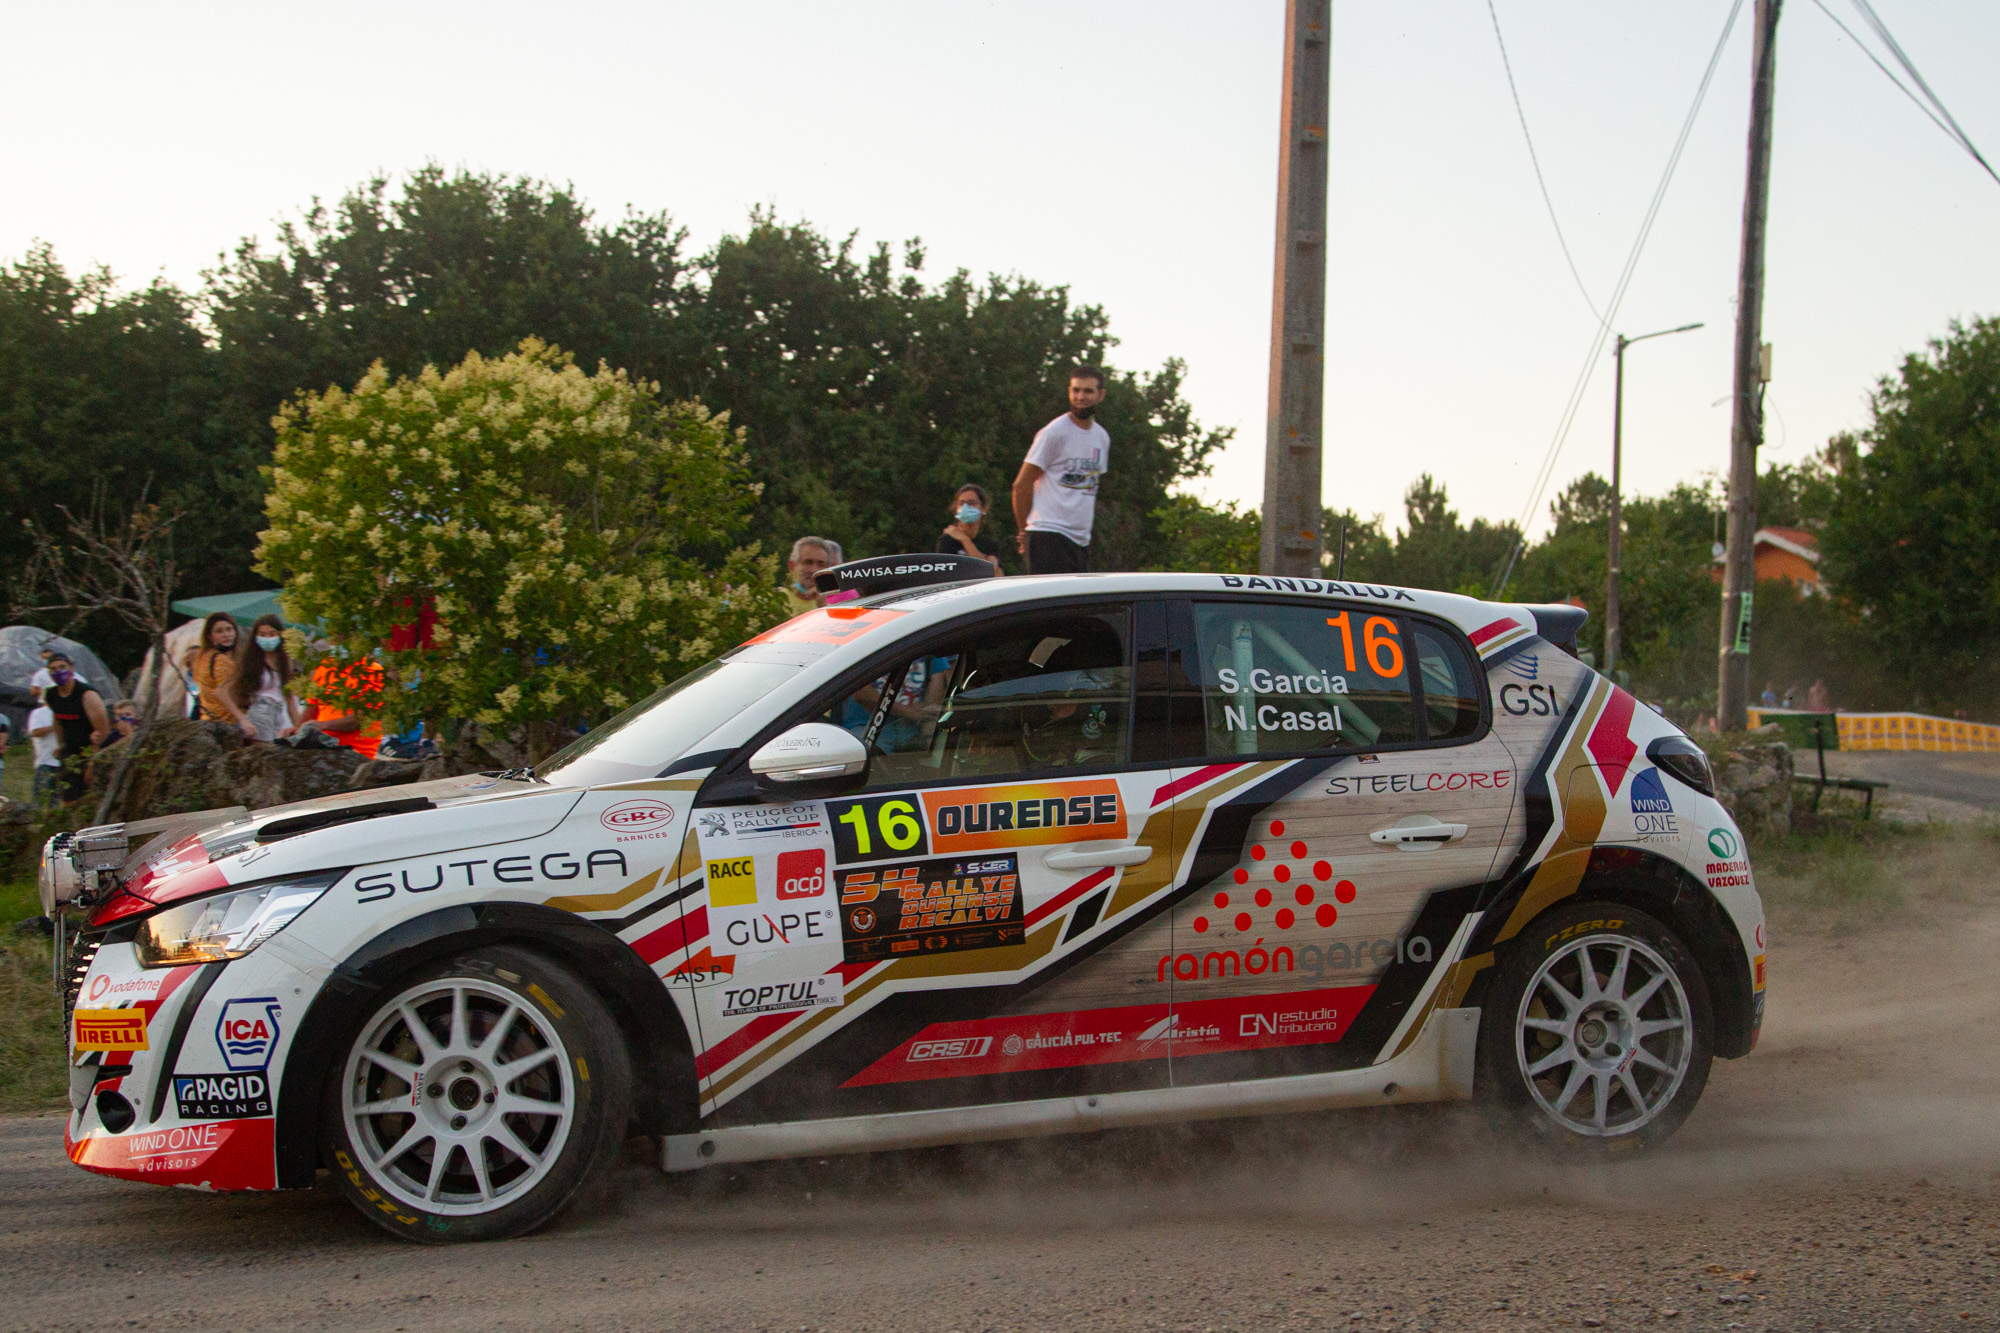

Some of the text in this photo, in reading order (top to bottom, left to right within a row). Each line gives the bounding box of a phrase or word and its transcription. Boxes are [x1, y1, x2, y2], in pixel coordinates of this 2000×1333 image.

[840, 562, 957, 579] MAVISA SPORT
[1219, 575, 1416, 603] BANDALUX
[1327, 611, 1405, 679] 16
[1218, 667, 1349, 695] S.Garcia
[1500, 683, 1560, 717] GSI
[1224, 705, 1343, 732] N.Casal
[1325, 769, 1511, 795] STEELCORE
[732, 804, 817, 820] PEUGEOT
[936, 793, 1118, 837] OURENSE
[1633, 798, 1670, 813] WIND
[609, 807, 673, 825] GBC
[733, 813, 820, 829] RALLY CUP
[1634, 814, 1679, 832] ONE
[616, 831, 668, 843] BARNICES
[839, 800, 921, 854] 16
[1635, 834, 1681, 843] advisors
[354, 848, 628, 904] SUTEGA
[710, 860, 753, 880] RACC
[1706, 861, 1748, 875] MADERAS
[784, 875, 823, 894] acp
[840, 867, 921, 906] 54
[903, 874, 1018, 902] RALLYE
[1707, 875, 1750, 888] VAZQUEZ
[900, 890, 1014, 915] OURENSE
[898, 904, 1012, 931] RECALVI
[109, 976, 161, 995] vodafone
[725, 981, 818, 1009] TOPTUL
[758, 1004, 768, 1012] OF
[816, 996, 836, 1004] TOOLS
[1279, 1008, 1337, 1023] estudio
[75, 1017, 144, 1045] PIRELLI
[225, 1019, 270, 1040] ICA
[1279, 1020, 1337, 1034] tributario
[912, 1041, 966, 1059] CRS
[194, 1075, 266, 1102] PAGID
[180, 1100, 269, 1115] RACING
[129, 1123, 219, 1152] WIND ONE
[137, 1156, 198, 1174] advisors
